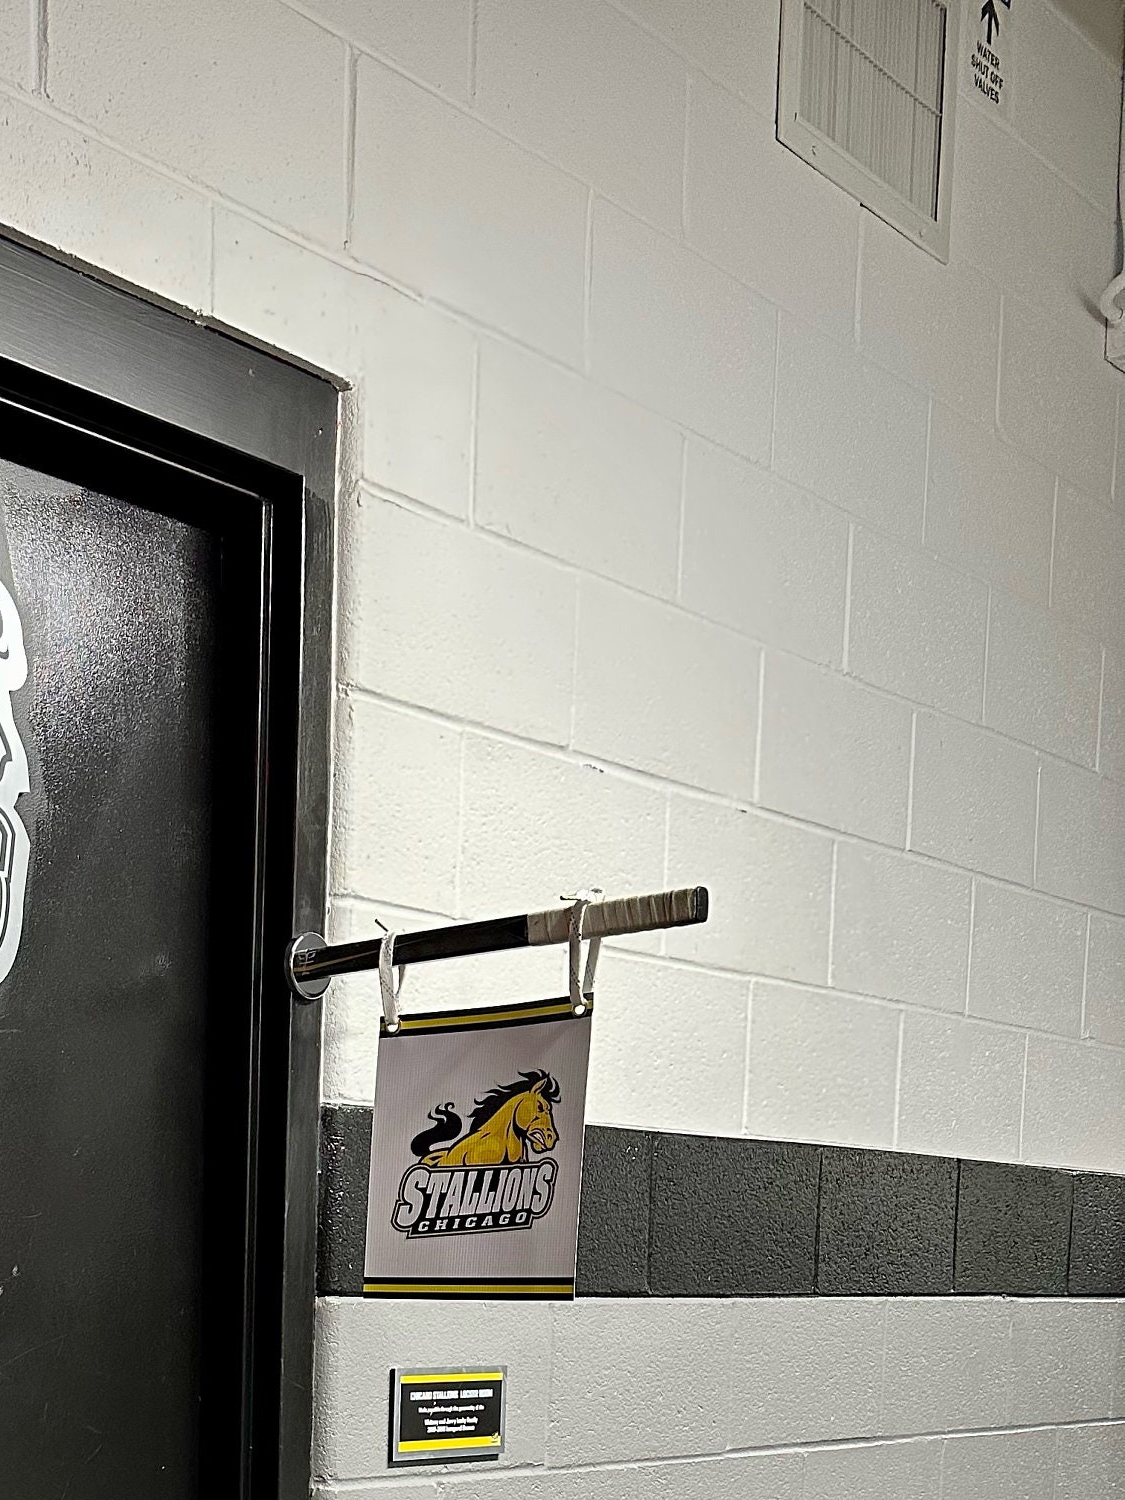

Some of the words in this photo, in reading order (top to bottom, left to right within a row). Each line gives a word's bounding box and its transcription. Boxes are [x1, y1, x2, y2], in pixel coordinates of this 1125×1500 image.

[977, 40, 1000, 70] WATER
[971, 54, 989, 78] SHUT
[990, 71, 1003, 90] OFF
[974, 73, 1000, 104] VALVES
[399, 1162, 554, 1228] STALLIONS
[418, 1211, 528, 1232] CHICAGO
